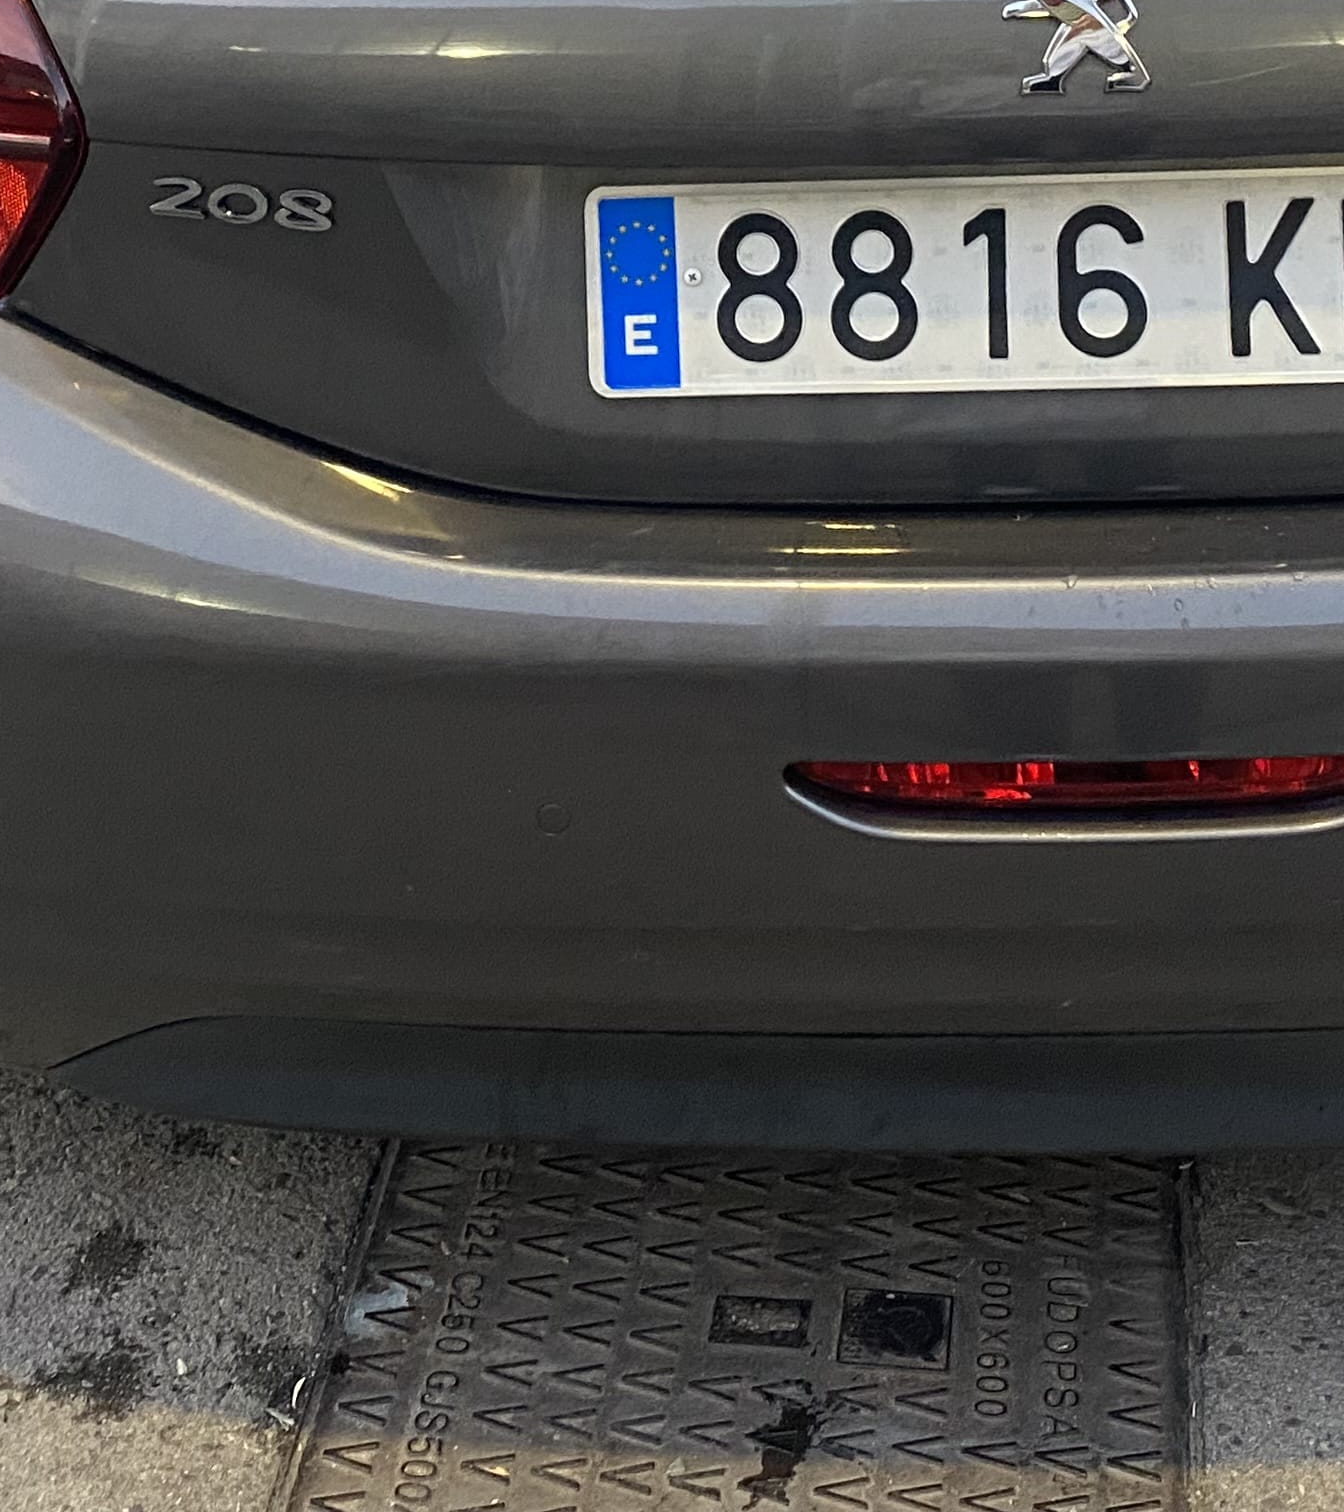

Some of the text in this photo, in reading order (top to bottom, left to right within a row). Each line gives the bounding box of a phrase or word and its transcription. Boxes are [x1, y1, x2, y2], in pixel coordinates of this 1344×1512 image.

[149, 176, 333, 231] 208
[624, 314, 658, 356] E
[716, 203, 1148, 363] 8816
[435, 1271, 485, 1355] C250
[974, 1260, 1012, 1416] 600X600
[394, 1370, 461, 1502] GJS500
